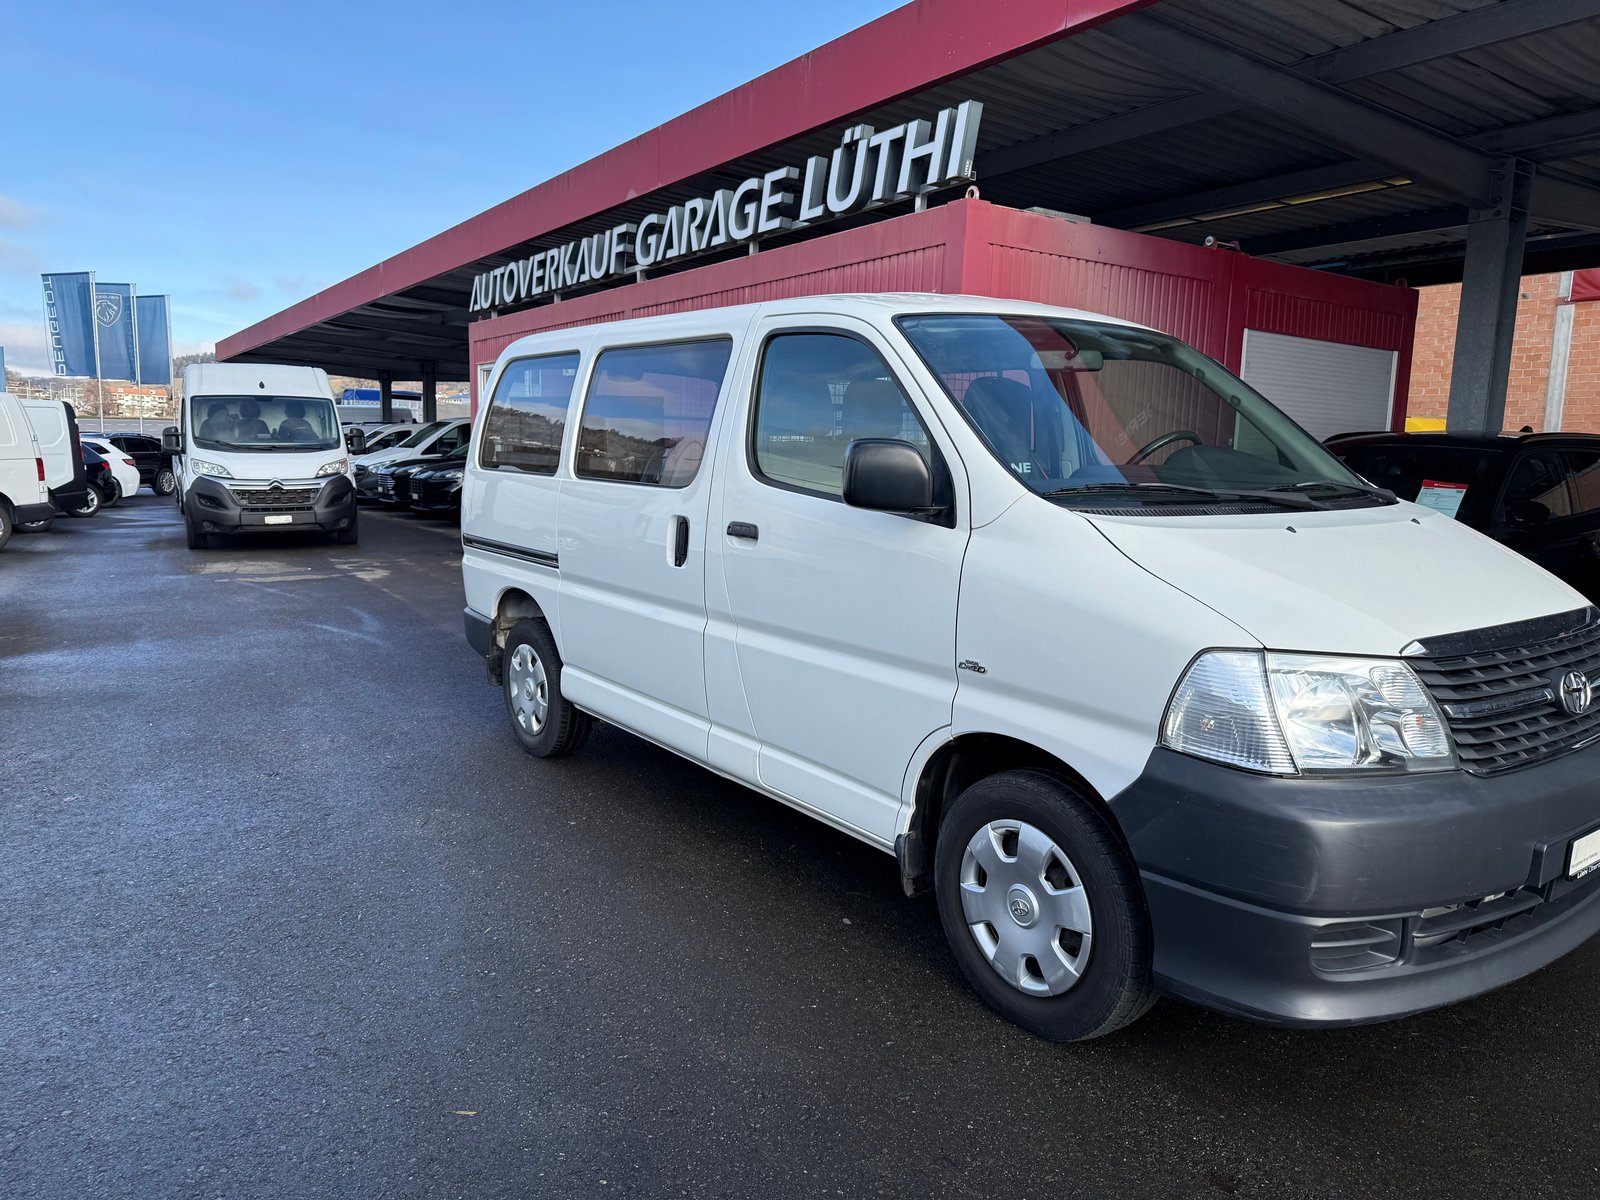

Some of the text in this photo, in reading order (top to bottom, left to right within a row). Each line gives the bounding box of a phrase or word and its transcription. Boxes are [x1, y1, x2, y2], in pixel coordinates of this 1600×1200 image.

[469, 99, 984, 312] AUTOVERKAUF GARAGE LÜTHI
[1010, 462, 1032, 474] NE
